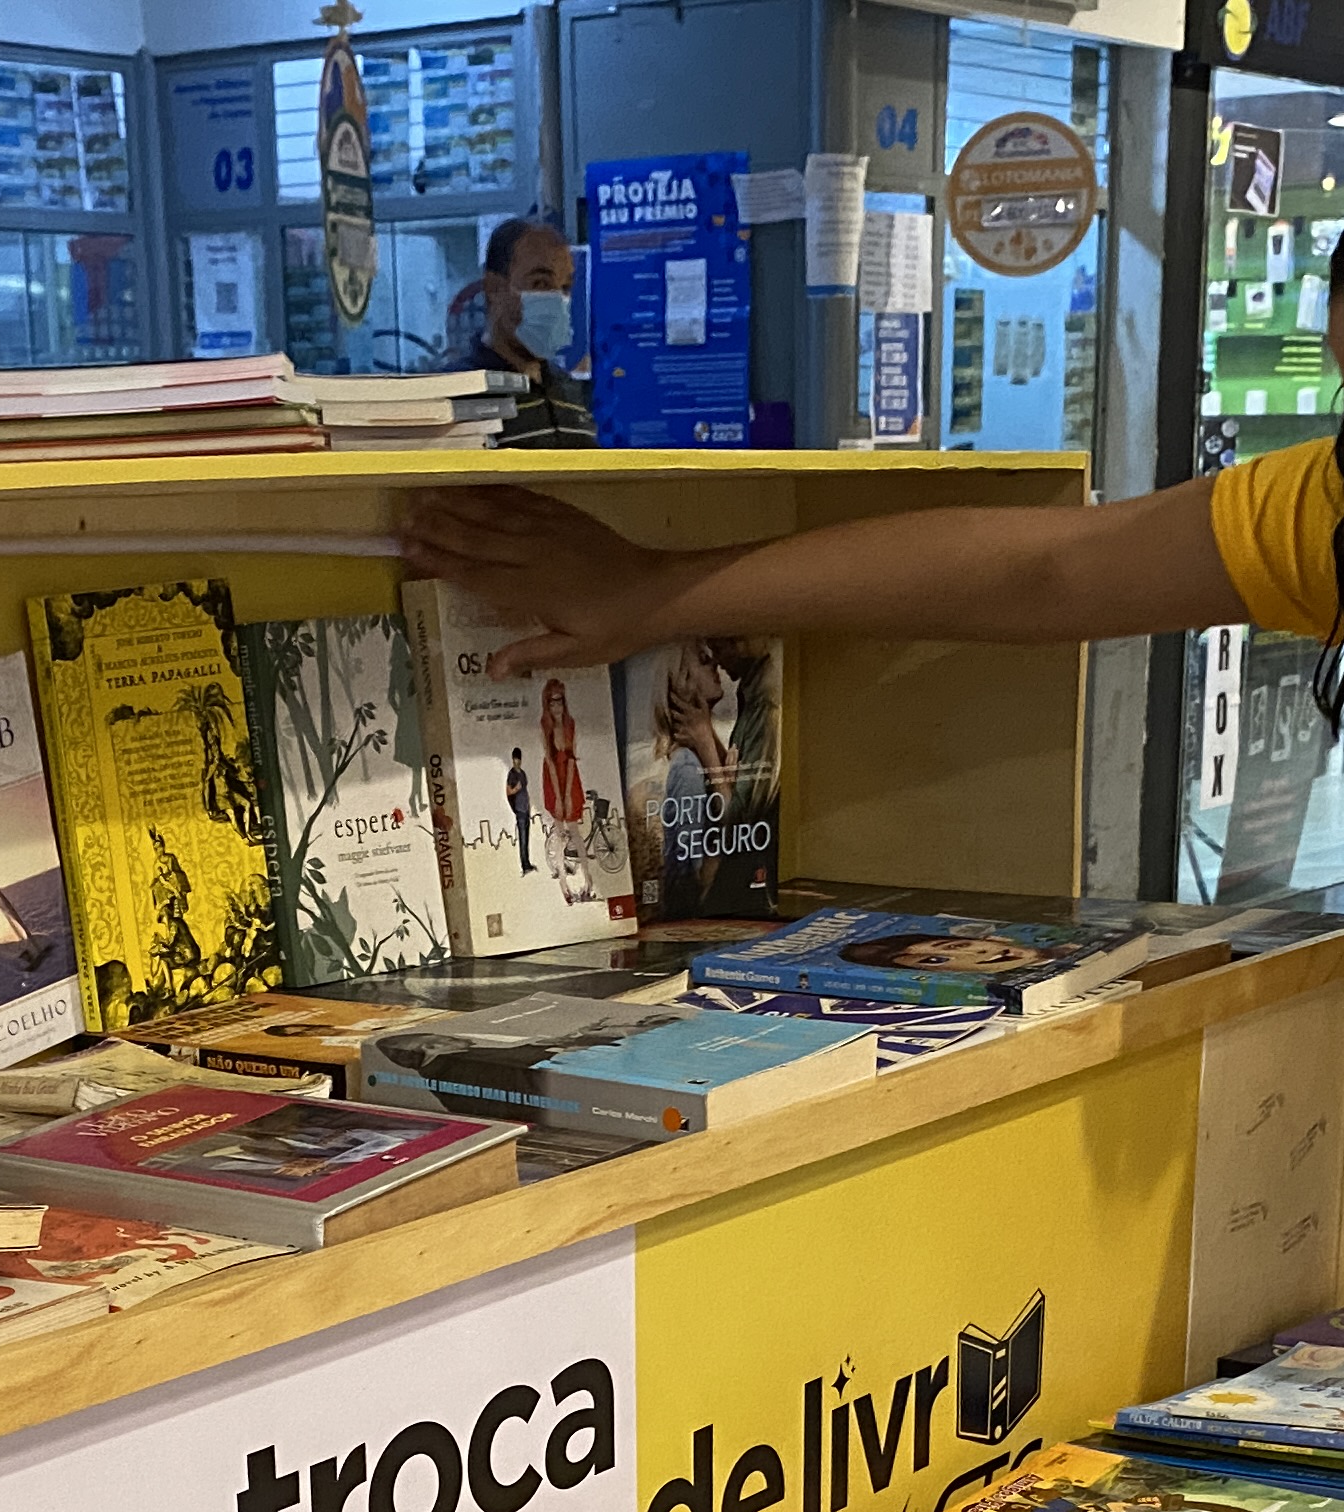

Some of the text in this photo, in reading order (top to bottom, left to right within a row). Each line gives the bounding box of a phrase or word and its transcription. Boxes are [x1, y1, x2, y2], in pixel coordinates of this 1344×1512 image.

[876, 105, 919, 150] 04
[214, 147, 254, 192] 03
[105, 662, 223, 691] TERRA PAPAGALLI
[457, 653, 482, 676] OS
[429, 754, 444, 779] OS
[645, 791, 725, 830] PORTO
[332, 807, 401, 843] espera
[676, 821, 771, 862] SEGURO
[260, 814, 284, 899] espera
[337, 848, 366, 868] maggie
[746, 972, 781, 985] Games
[206, 1055, 233, 1071] NÃO
[591, 1105, 623, 1121] Carlos
[111, 1275, 143, 1292] novel
